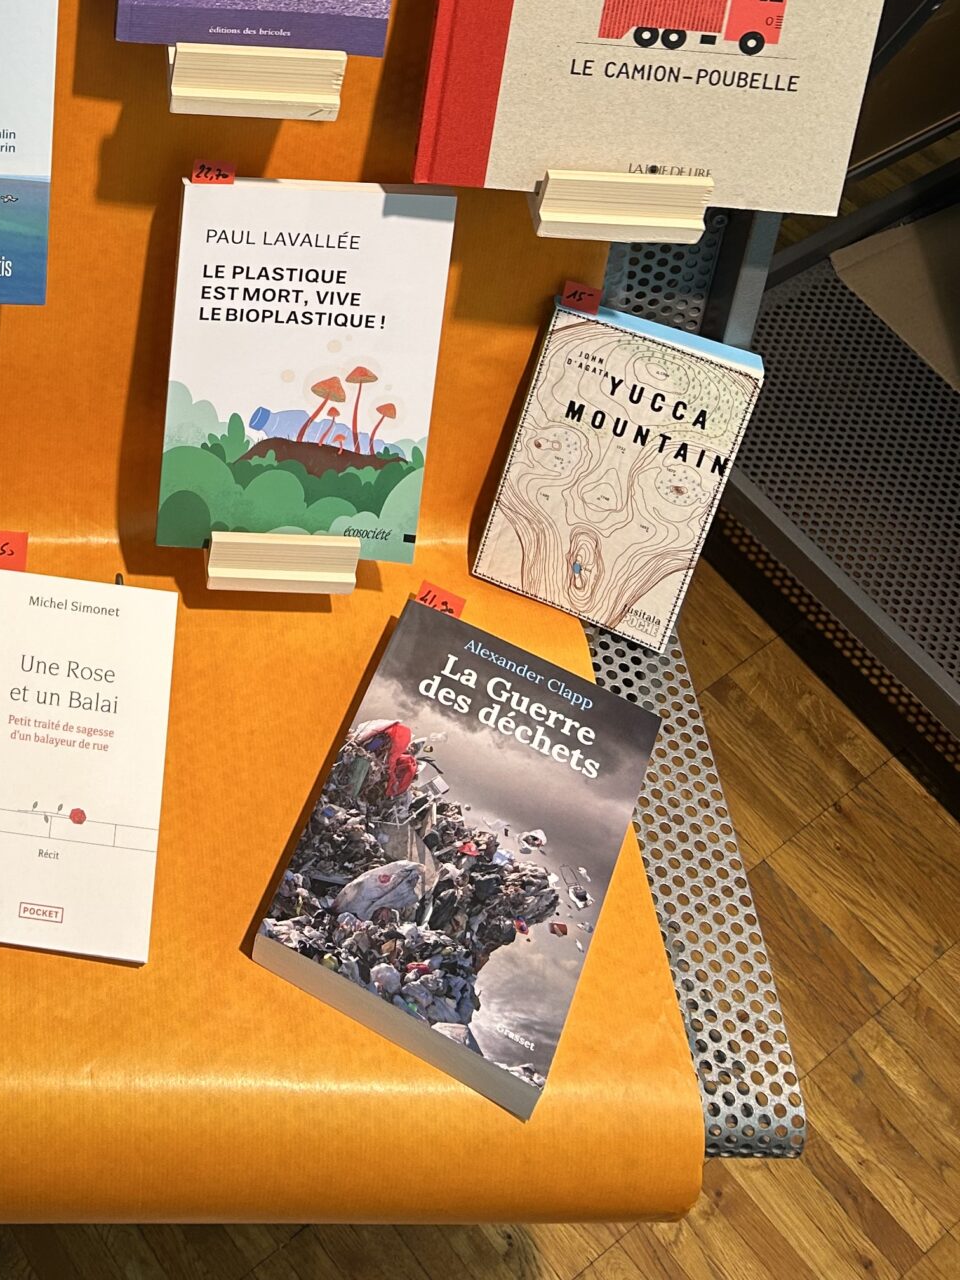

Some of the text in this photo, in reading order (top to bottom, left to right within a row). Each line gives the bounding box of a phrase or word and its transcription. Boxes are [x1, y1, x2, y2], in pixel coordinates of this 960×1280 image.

[209, 25, 291, 37] éditions des bricoles
[570, 58, 801, 92] LE CAMION-POUBELLE
[205, 228, 361, 250] PAUL LAVALLÉE
[202, 264, 348, 285] LE PLASTIQUE
[200, 286, 362, 307] EST MORT, VIVE
[199, 307, 221, 322] LE
[225, 308, 376, 329] BIOPLASTIQUE
[605, 375, 708, 431] YUCCA
[564, 400, 732, 477] MOUNTAIN
[343, 526, 392, 541] écosociété
[29, 595, 120, 617] Michel Simonet
[20, 654, 116, 684] Une Rose
[464, 639, 593, 711] Alexander Clapp
[9, 685, 119, 714] et un Balai
[440, 653, 596, 747] La Guerre
[7, 714, 115, 738] Petit traité de sagesse
[418, 675, 600, 780] des déchets
[33, 733, 76, 748] balayeur
[78, 737, 90, 749] de
[92, 741, 109, 752] rue
[38, 848, 60, 860] Récit
[22, 906, 59, 919] POCKET
[496, 1023, 535, 1052] Grasset
